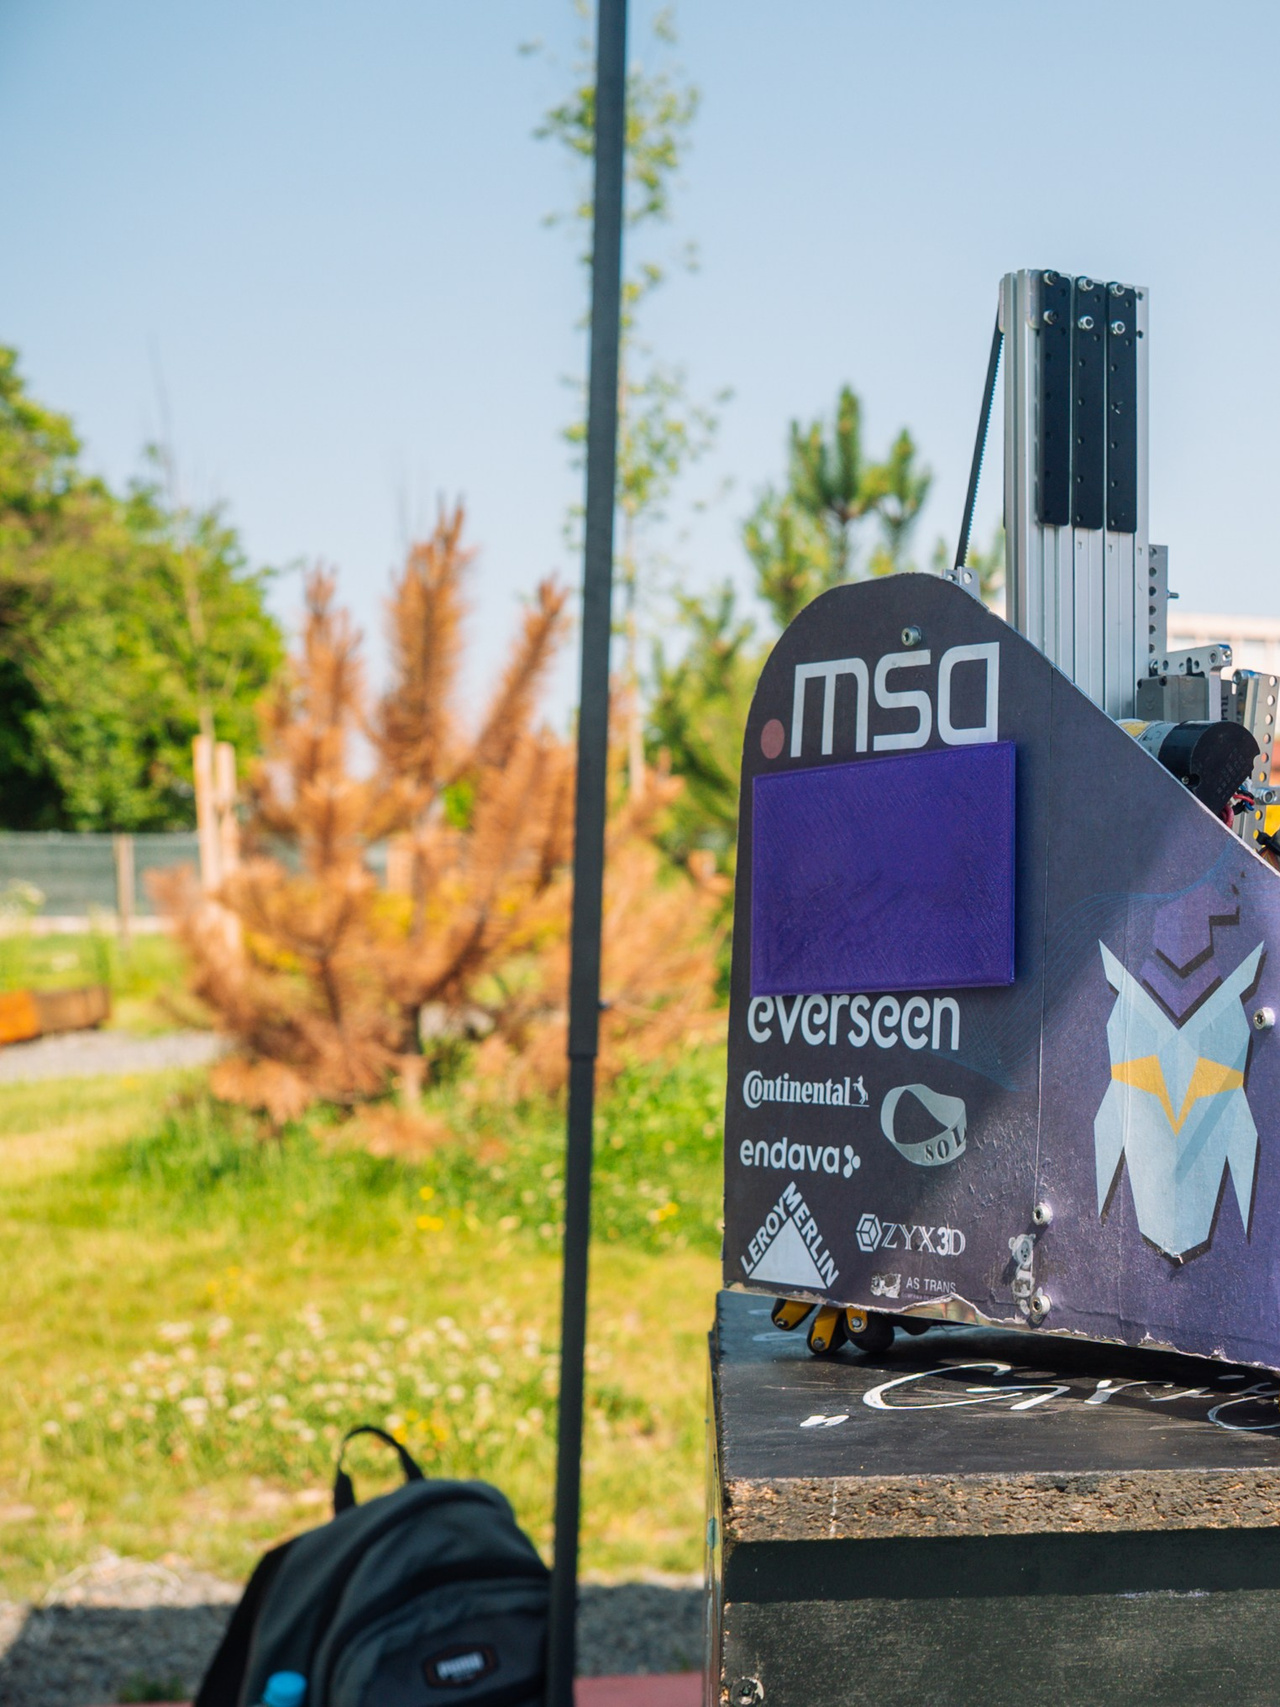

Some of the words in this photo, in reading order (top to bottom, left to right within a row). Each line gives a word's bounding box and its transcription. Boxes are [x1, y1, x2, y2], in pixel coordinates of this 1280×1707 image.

[747, 994, 960, 1050] everseen
[743, 1070, 851, 1108] Continental
[739, 1137, 840, 1174] endava
[741, 1196, 788, 1275] LEROY
[782, 1181, 840, 1288] MERLIN
[905, 1276, 920, 1290] AS
[924, 1278, 957, 1294] TRANS
